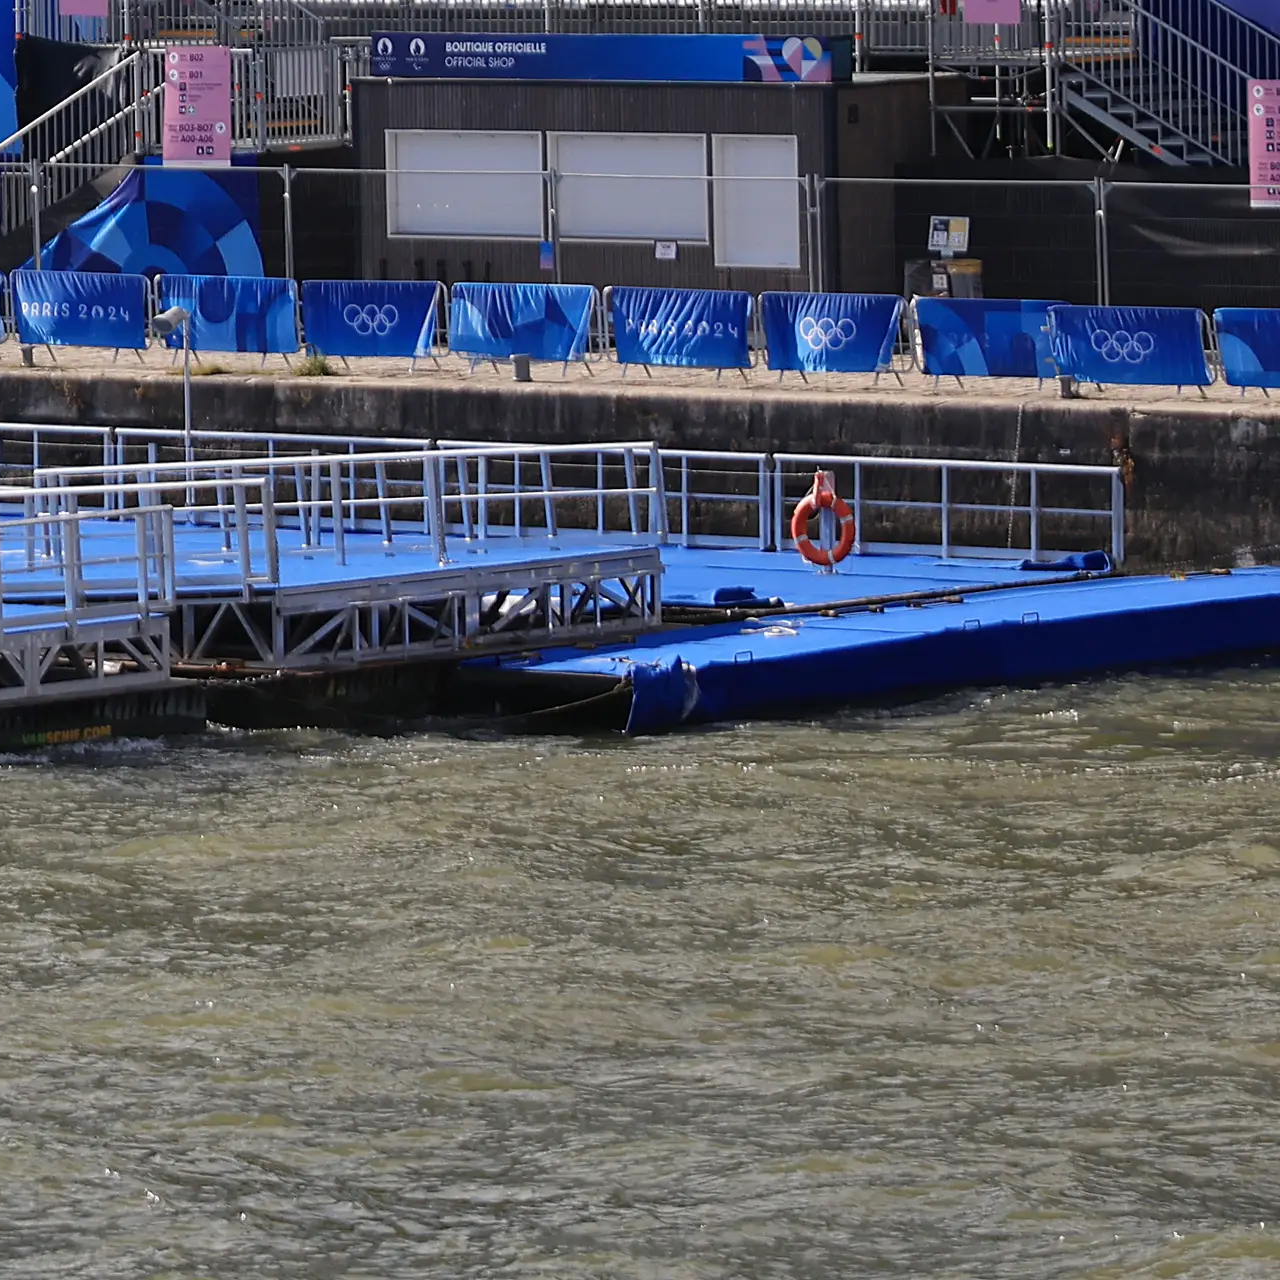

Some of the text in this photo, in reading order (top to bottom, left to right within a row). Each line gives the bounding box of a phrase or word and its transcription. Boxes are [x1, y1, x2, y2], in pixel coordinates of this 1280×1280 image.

[445, 41, 547, 53] BOUTIQUE OFFICIELLE
[444, 56, 515, 67] OFFICIAL SHOP
[78, 303, 130, 322] 2024
